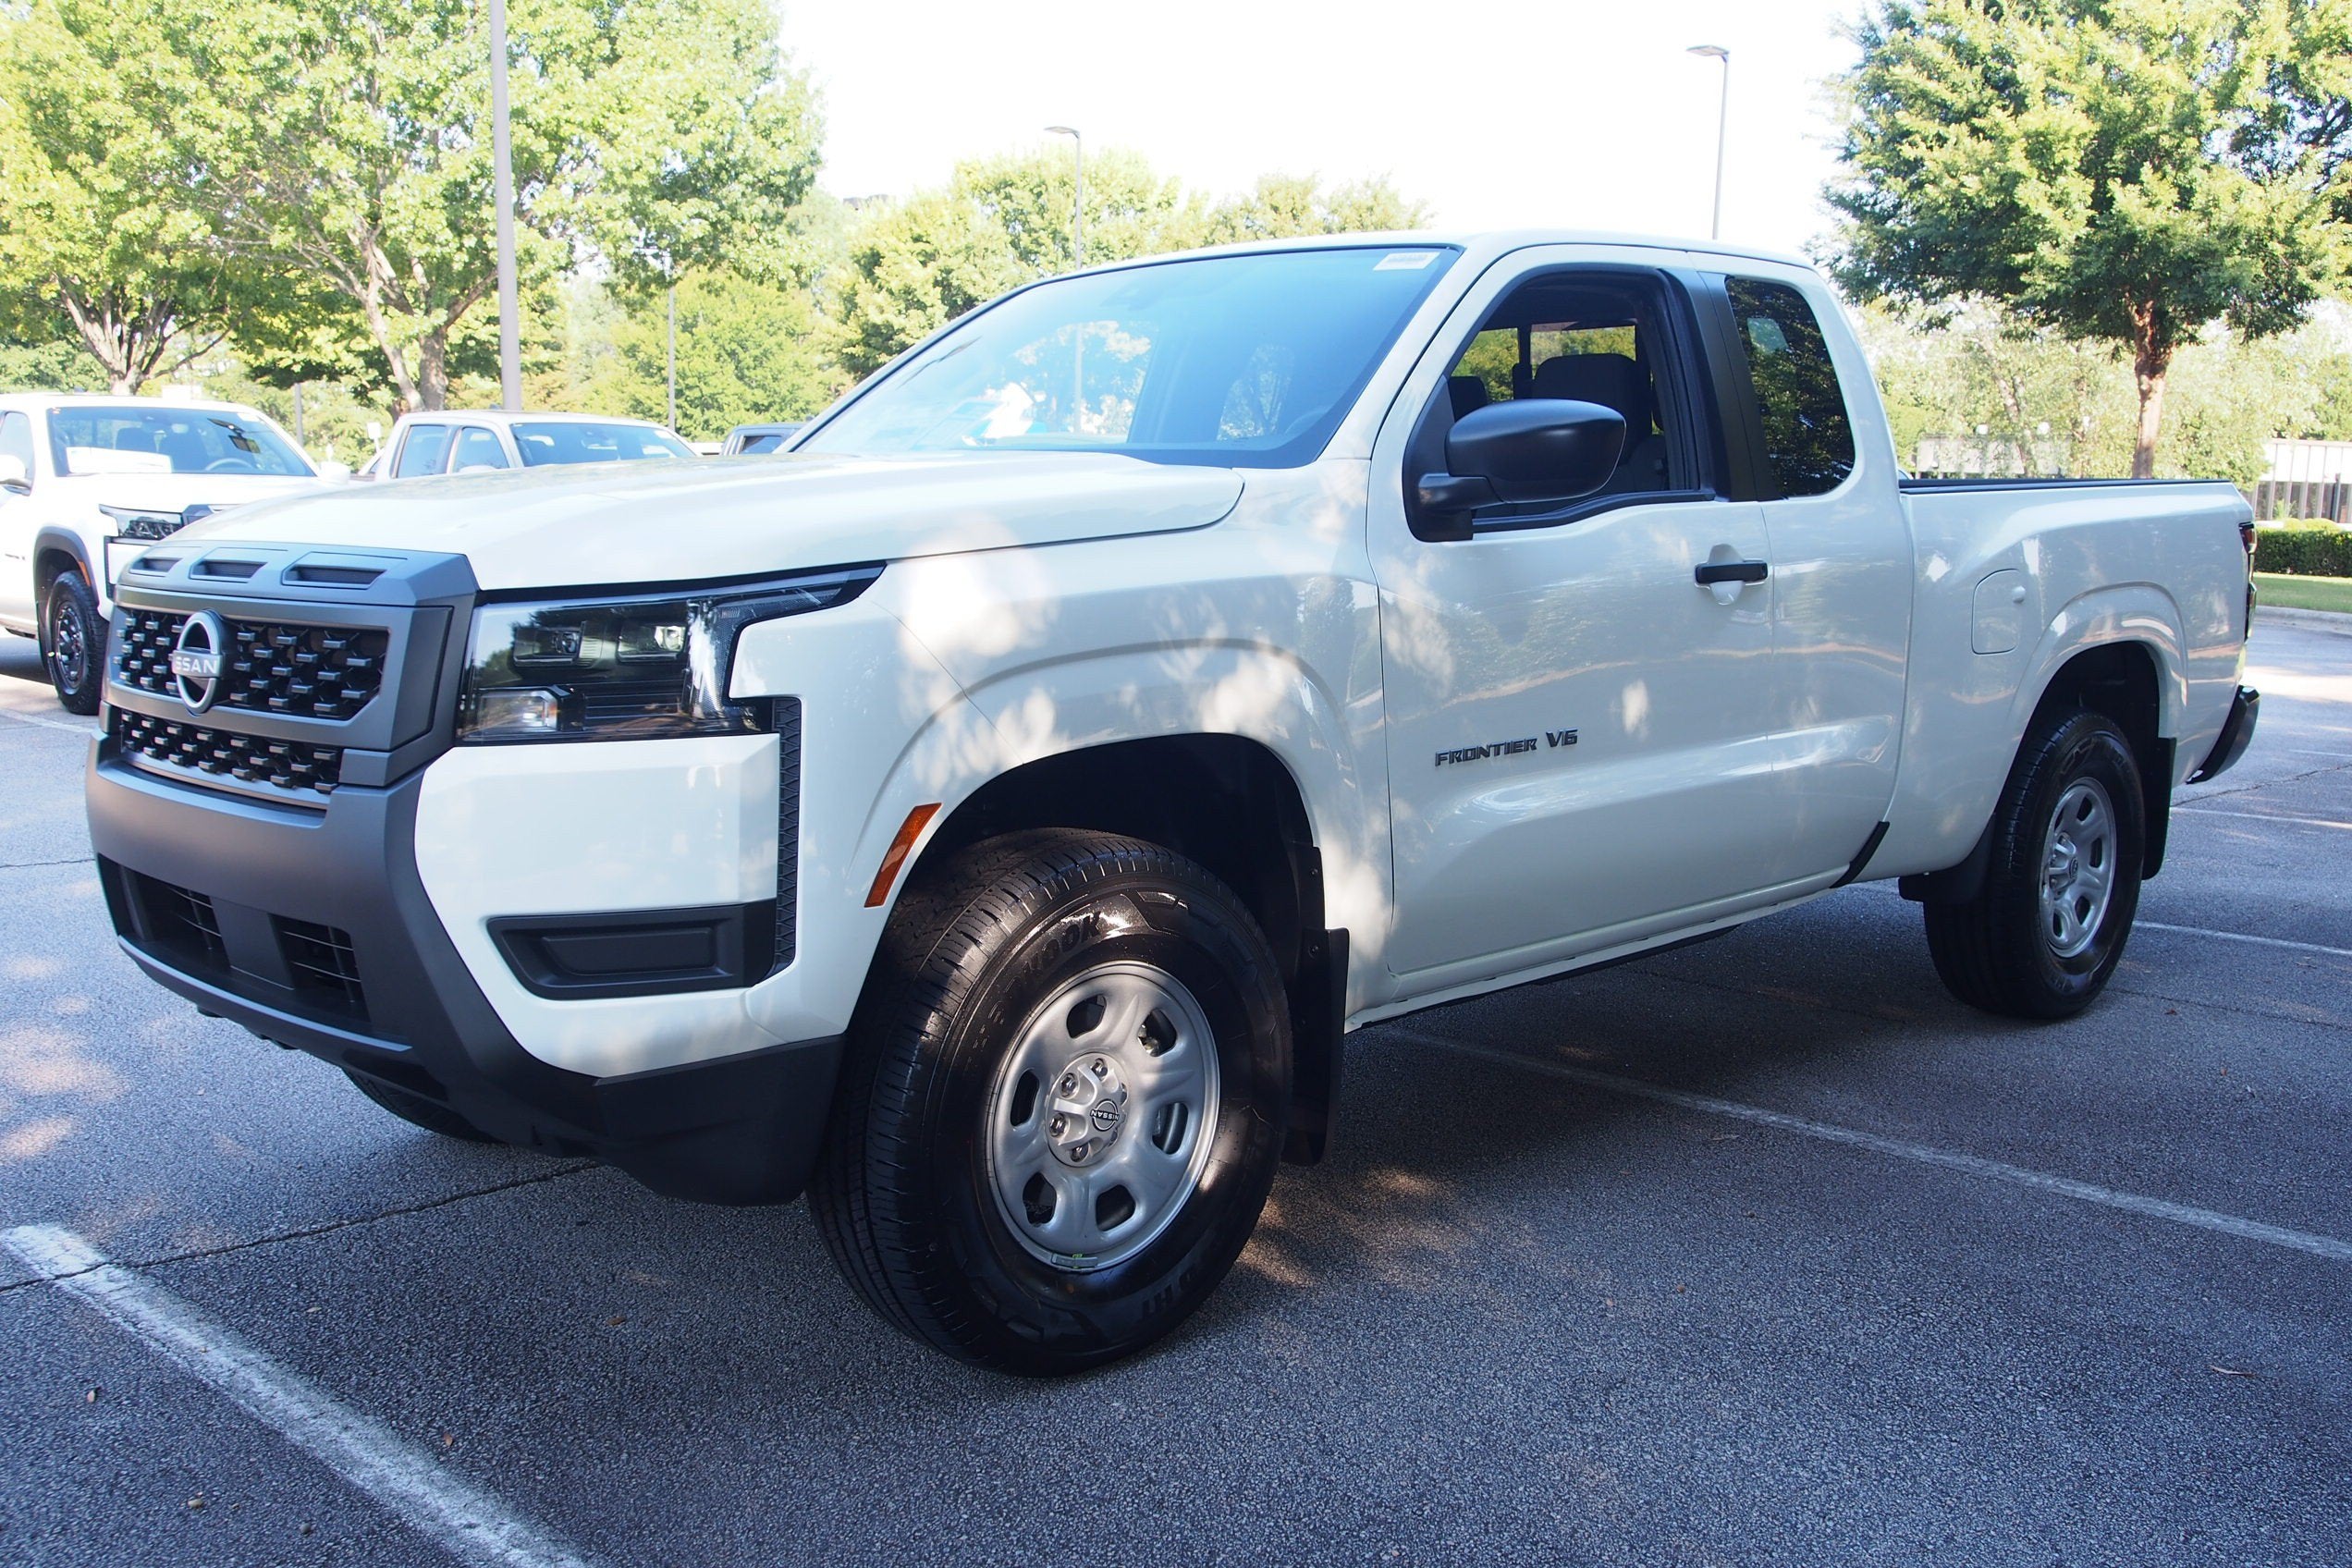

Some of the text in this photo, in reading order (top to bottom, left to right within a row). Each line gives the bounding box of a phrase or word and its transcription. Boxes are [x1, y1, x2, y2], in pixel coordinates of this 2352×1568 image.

[176, 656, 217, 674] SSAN
[1435, 729, 1578, 767] FRONTIER V6
[1091, 1110, 1120, 1121] NISSAN
